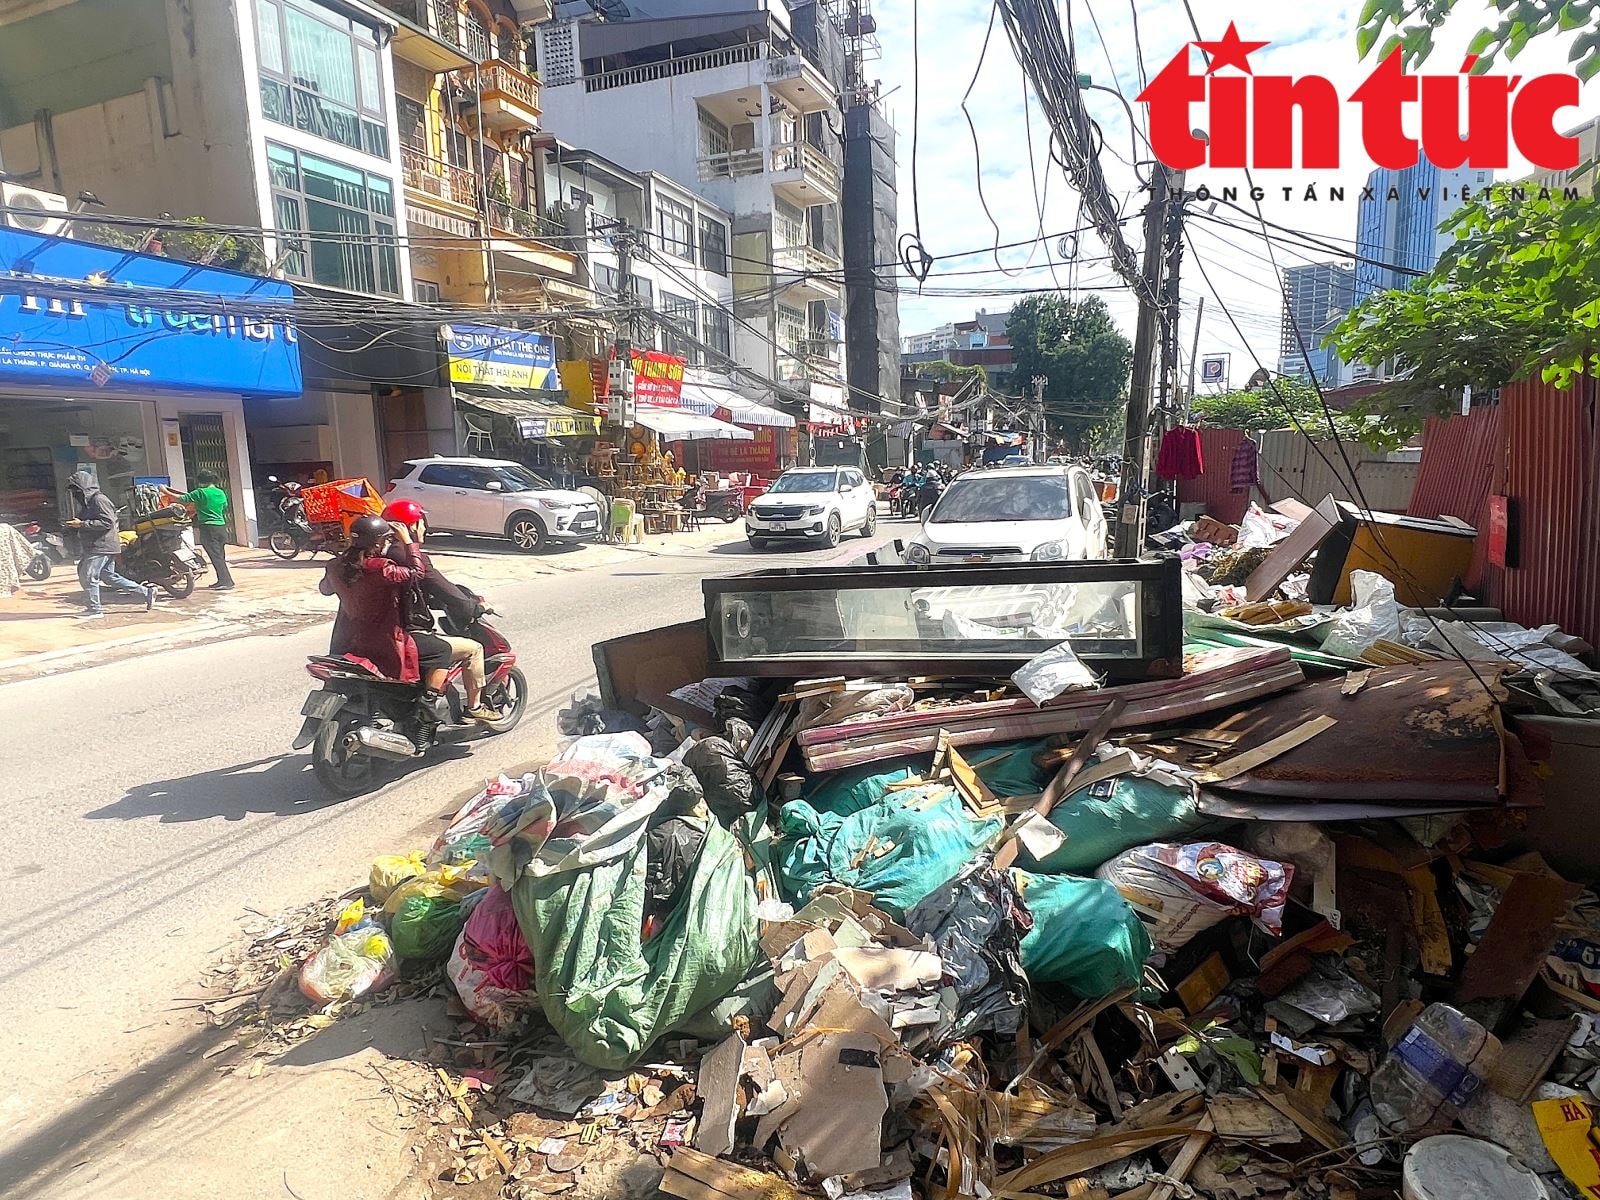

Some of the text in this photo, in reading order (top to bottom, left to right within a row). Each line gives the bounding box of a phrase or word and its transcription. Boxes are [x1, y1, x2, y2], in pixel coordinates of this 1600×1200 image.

[475, 334, 492, 348] NỘI
[493, 336, 516, 350] THẤT
[517, 341, 534, 353] THE
[534, 344, 551, 355] ONE
[512, 369, 529, 379] ANH
[644, 360, 668, 378] THANH
